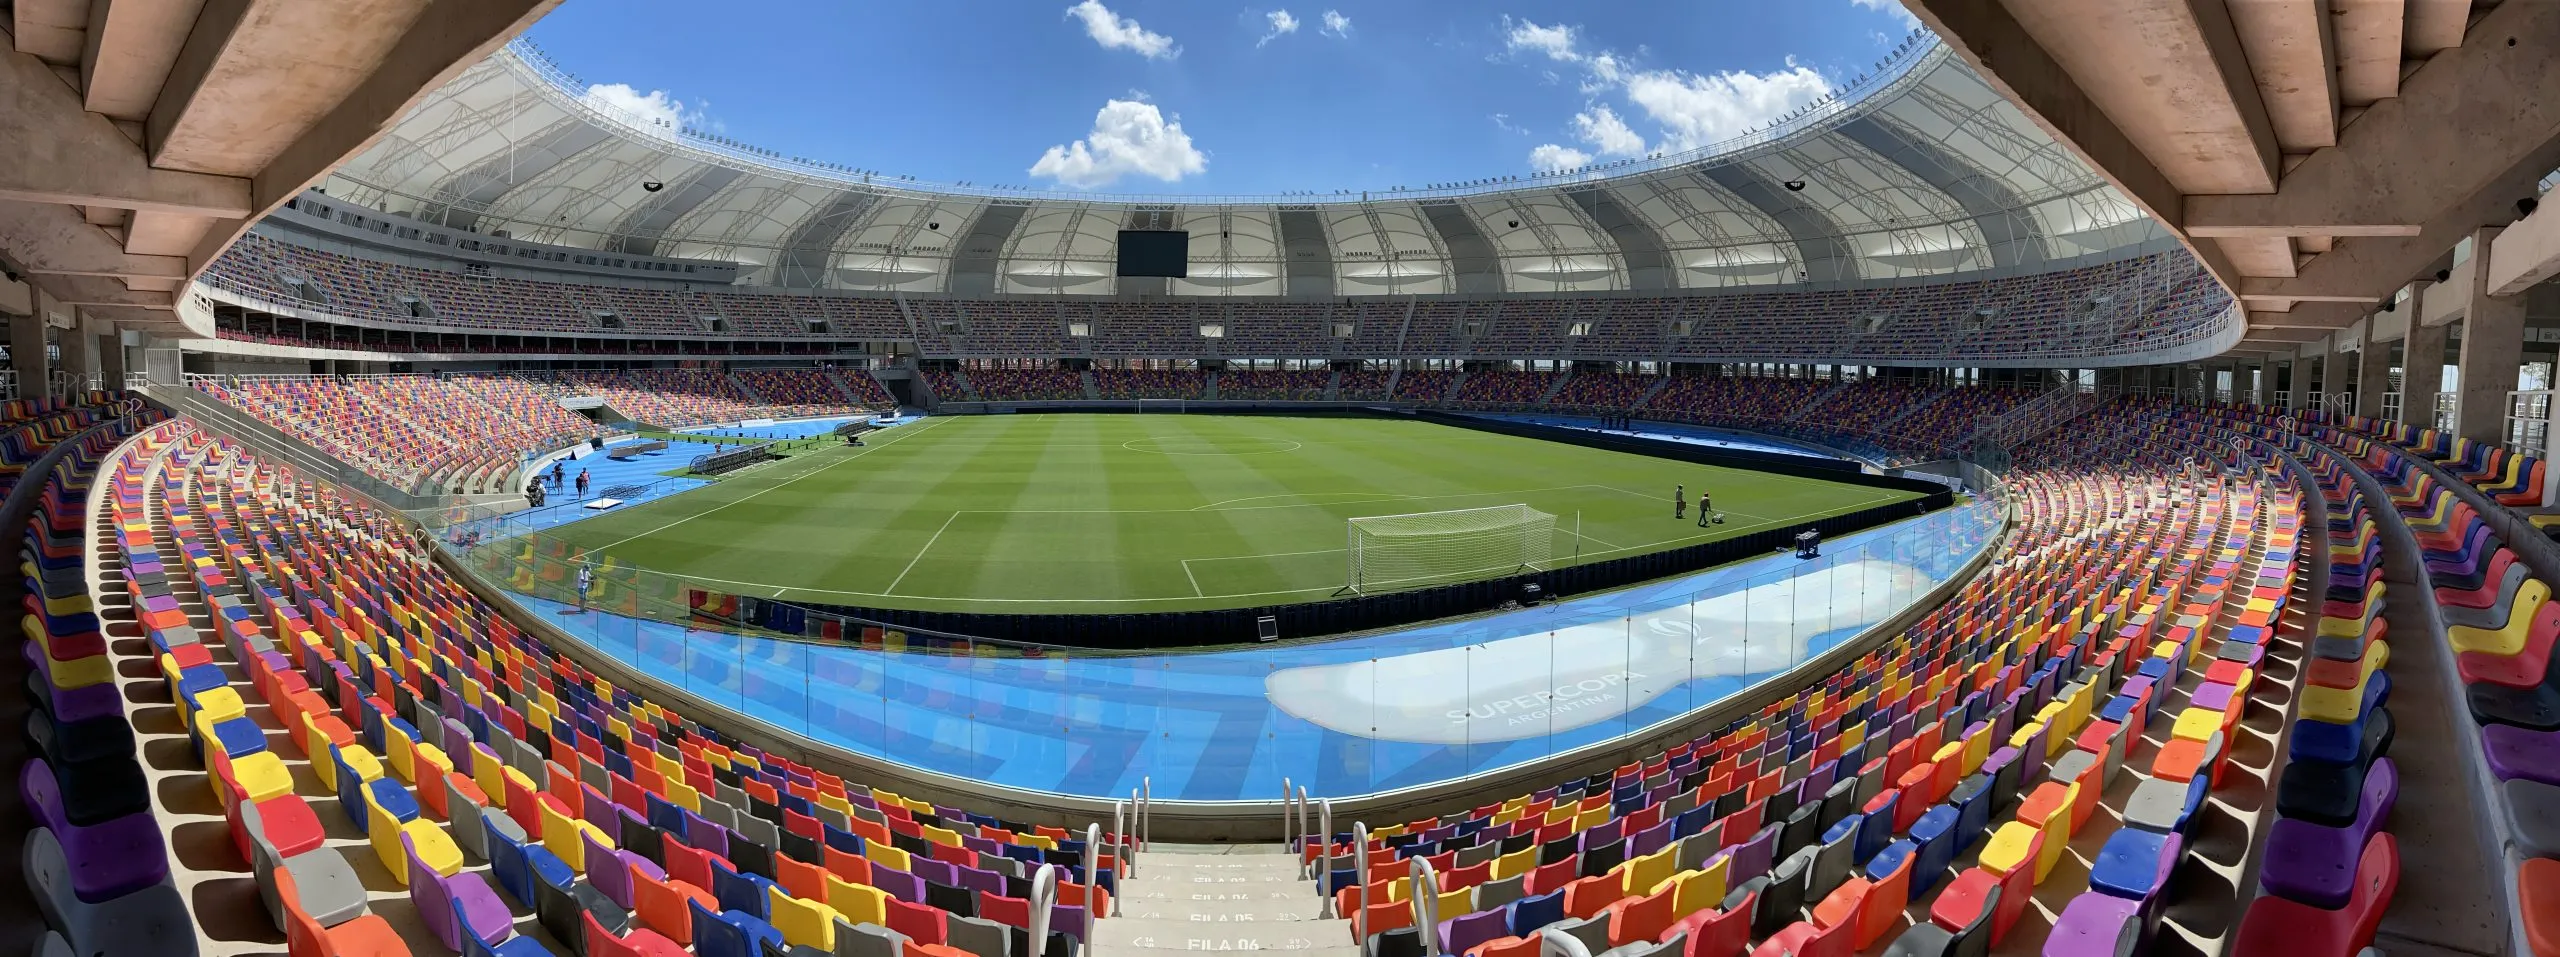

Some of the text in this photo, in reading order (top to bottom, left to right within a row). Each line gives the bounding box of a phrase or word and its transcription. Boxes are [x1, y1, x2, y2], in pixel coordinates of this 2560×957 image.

[1446, 670, 1647, 724] SUPERCOPA
[1508, 692, 1616, 726] ARGENTINA
[1187, 938, 1260, 951] FILA 06
